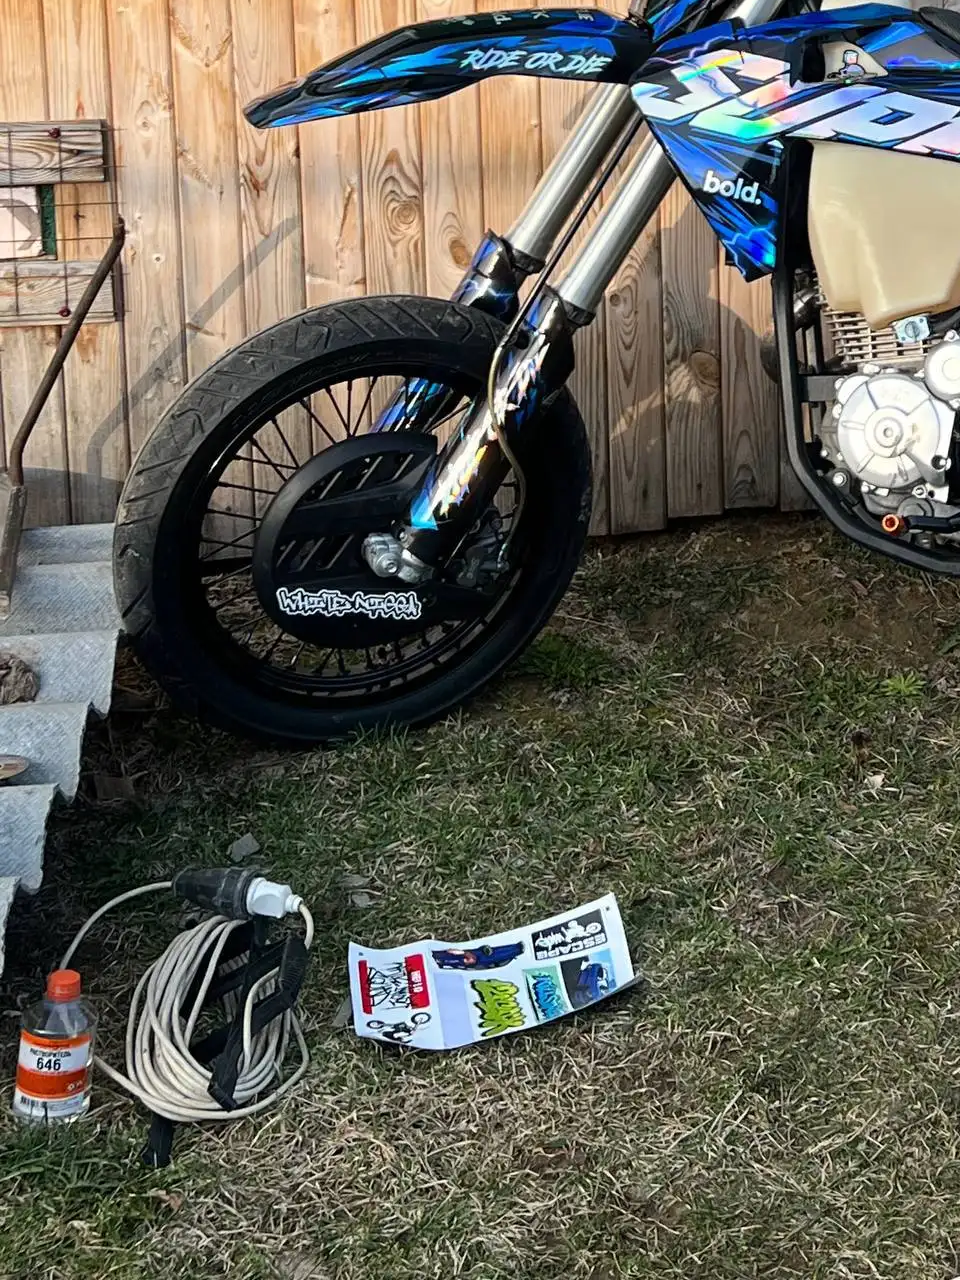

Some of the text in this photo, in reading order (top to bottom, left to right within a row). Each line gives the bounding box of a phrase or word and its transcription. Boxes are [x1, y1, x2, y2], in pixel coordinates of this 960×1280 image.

[459, 48, 612, 74] RIDE OR DIE
[703, 170, 762, 205] bold.
[277, 587, 353, 616] WHITE
[536, 933, 607, 960] ESCAPE
[36, 1057, 62, 1071] 646
